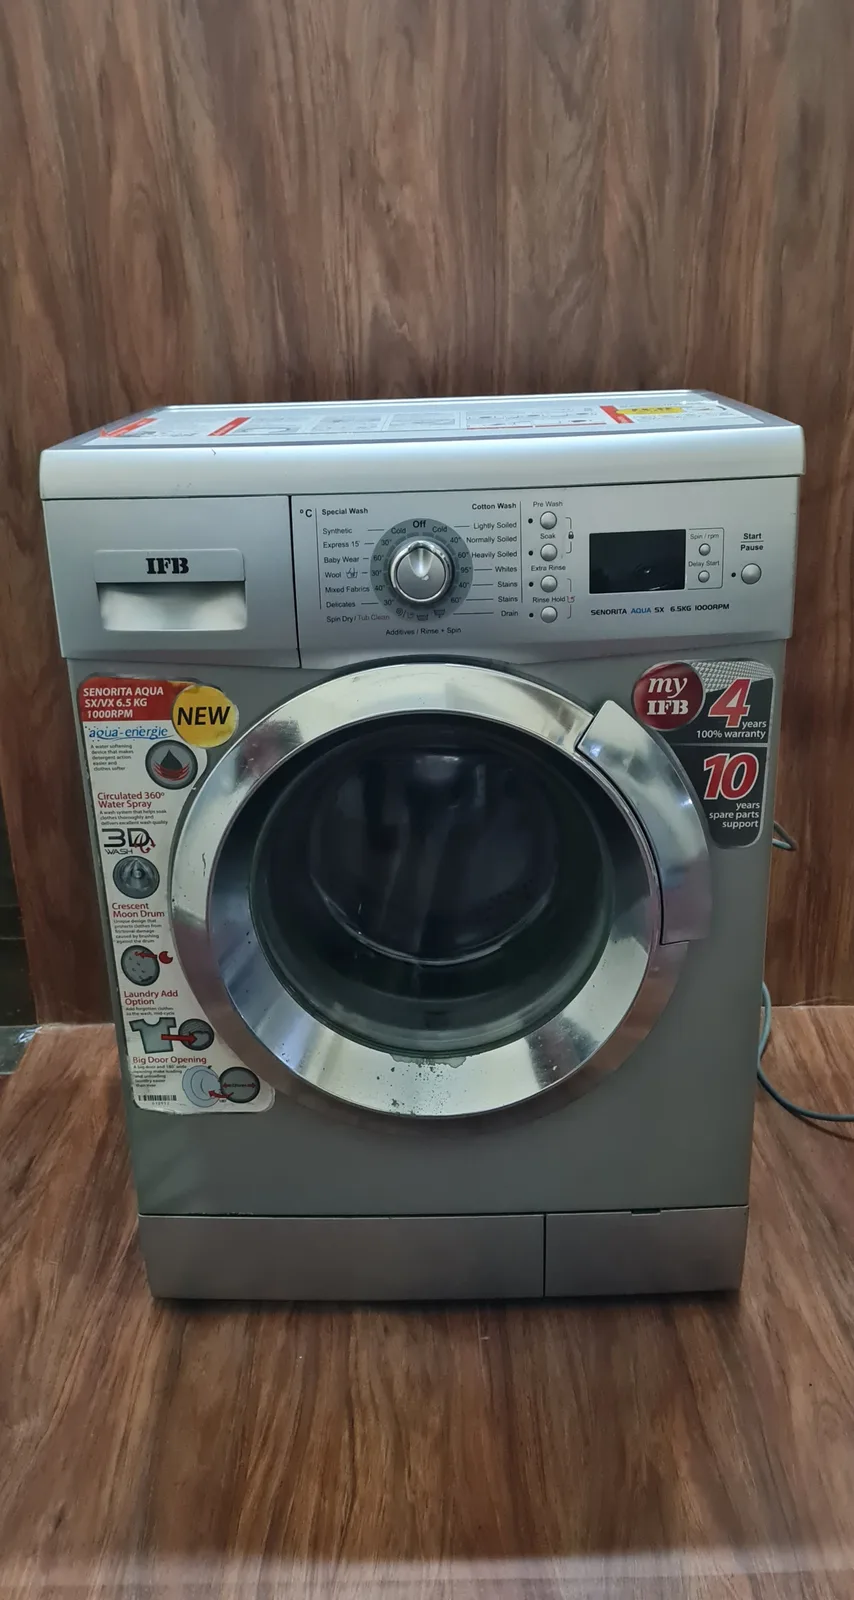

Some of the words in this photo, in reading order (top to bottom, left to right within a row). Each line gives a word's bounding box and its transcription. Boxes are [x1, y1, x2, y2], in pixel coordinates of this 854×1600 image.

[497, 502, 517, 510] Wash
[321, 508, 347, 516] Special
[350, 507, 369, 515] Wash
[412, 520, 427, 528] Off
[473, 522, 496, 531] Lightly
[497, 521, 517, 529] Soiled
[323, 527, 353, 535] Synthetic
[391, 527, 407, 535] Cold
[466, 536, 495, 544] Normally
[497, 535, 518, 543] Soiled
[540, 532, 556, 540] Soak
[743, 532, 762, 540] Start
[323, 541, 349, 549] Express
[740, 544, 764, 552] Pause
[323, 556, 341, 564] Baby
[342, 555, 360, 563] Wear
[471, 552, 496, 560] Heavily
[145, 557, 190, 575] IFB
[688, 560, 705, 568] Delay
[706, 559, 720, 567] Start
[346, 585, 370, 593] Fabrics
[532, 596, 550, 604] Rinse
[590, 608, 627, 616] SENORITA
[694, 603, 730, 611] 1000RPM
[326, 615, 341, 623] Spin
[371, 613, 390, 621] Clean
[385, 627, 416, 636] Additives
[420, 627, 439, 635] Rinse
[446, 626, 462, 634] Spin
[83, 687, 133, 697] SENORITA
[134, 686, 164, 697] AQUA
[647, 677, 688, 699] my
[84, 698, 115, 708] SX/VX
[116, 698, 132, 708] 6.5
[133, 697, 148, 708] KG
[707, 677, 751, 729] 4
[646, 699, 689, 716] IFB
[86, 709, 134, 719] 1000RPM
[177, 706, 231, 726] NEW
[741, 719, 767, 730] years
[696, 729, 723, 739] 100%
[724, 729, 767, 740] warranty
[703, 752, 760, 800] 10
[97, 791, 143, 800] Circulated
[97, 800, 125, 808] Water
[126, 800, 152, 809] Spray
[735, 802, 761, 811] years
[709, 811, 734, 821] spare
[735, 810, 760, 821] parts
[722, 819, 759, 830] support
[111, 902, 150, 910] Crescent
[112, 910, 139, 918] Moon
[140, 910, 166, 918] Drum
[123, 990, 160, 999] Laundry
[161, 989, 179, 997] Add
[124, 998, 155, 1007] Option
[132, 1056, 147, 1065] Big
[147, 1056, 169, 1064] Door
[170, 1055, 207, 1065] Opening
